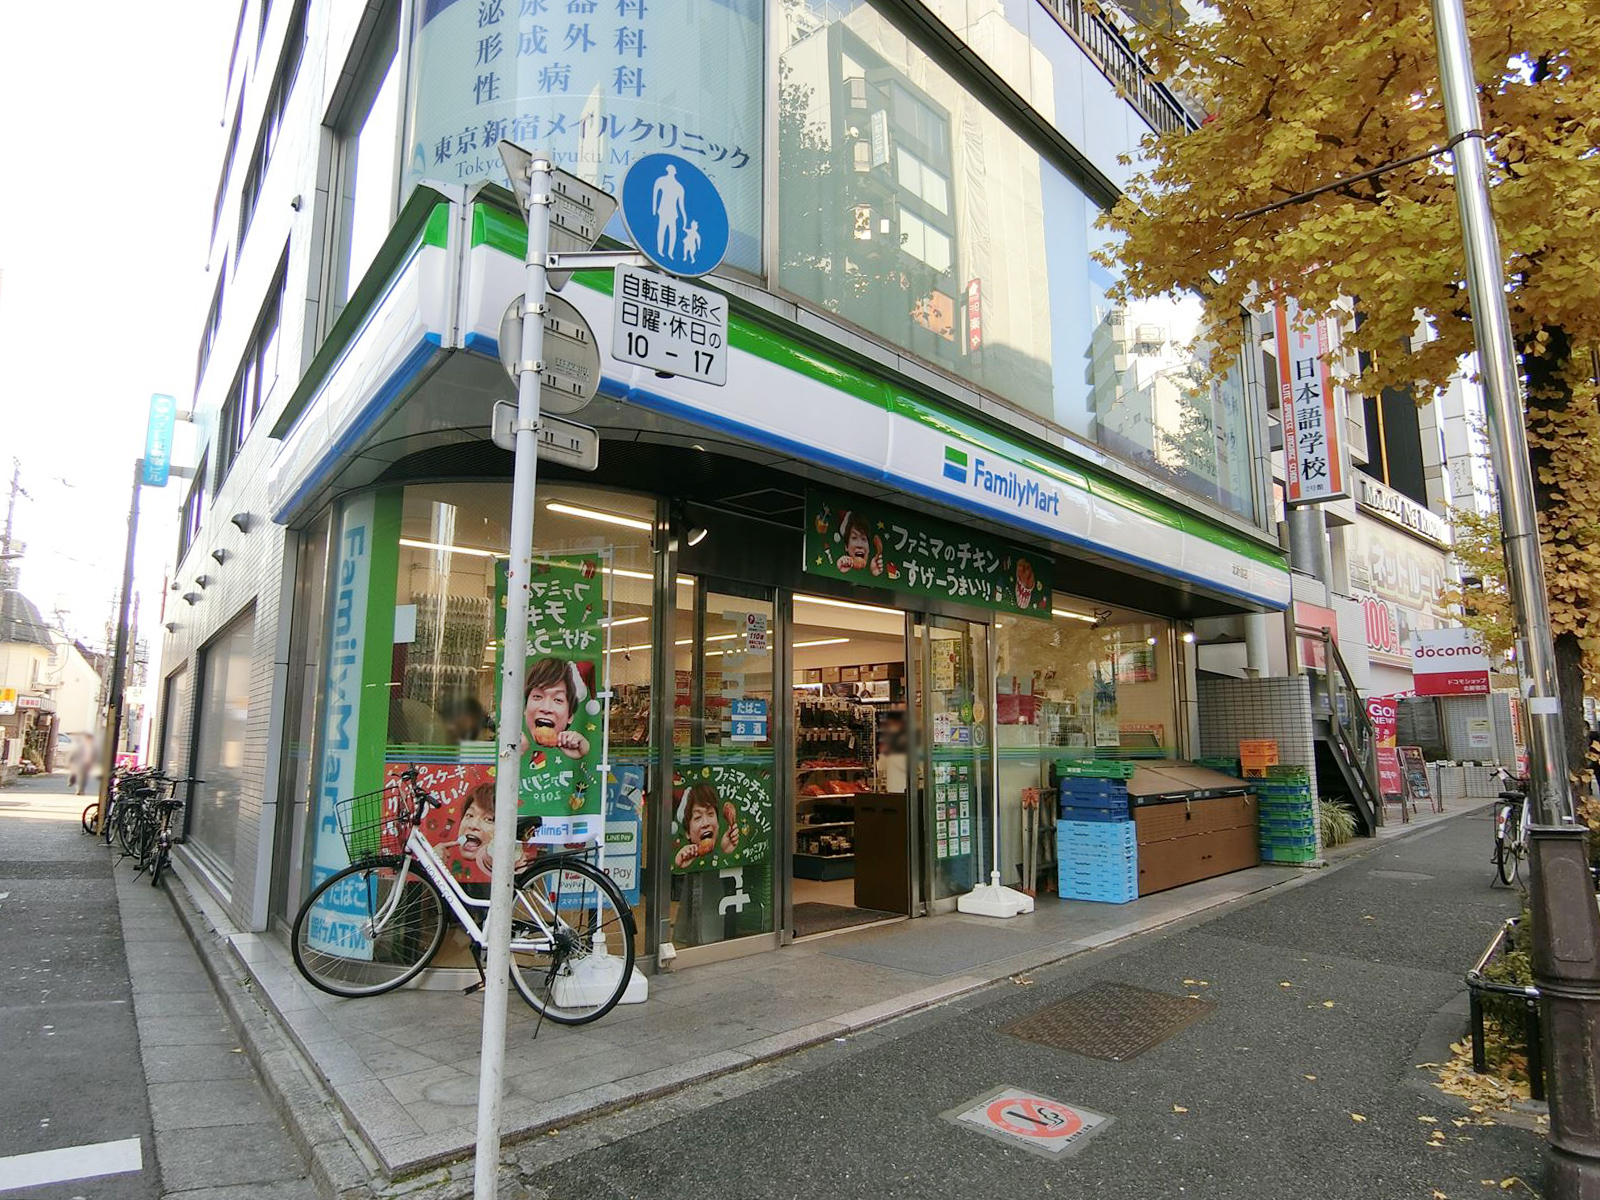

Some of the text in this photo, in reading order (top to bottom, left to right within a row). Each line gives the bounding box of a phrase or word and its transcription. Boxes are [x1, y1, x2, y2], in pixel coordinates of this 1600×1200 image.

[475, 23, 647, 68] 形成外科
[473, 62, 646, 105] 性病科
[433, 113, 750, 168] 東京新宿メイルクリニック
[623, 273, 721, 322] 自転車を除く
[622, 301, 722, 349] 日曜・休日の
[1295, 357, 1327, 481] 日本語学校
[974, 458, 1059, 516] FamilyMart
[892, 525, 1000, 573] ファミマのチキン
[1415, 646, 1482, 658] docomo
[321, 525, 365, 834] FamilyMart
[737, 702, 762, 714] たばこ
[713, 766, 772, 808] ファミマのチキン
[620, 834, 632, 842] Pay
[614, 868, 632, 879] Pay
